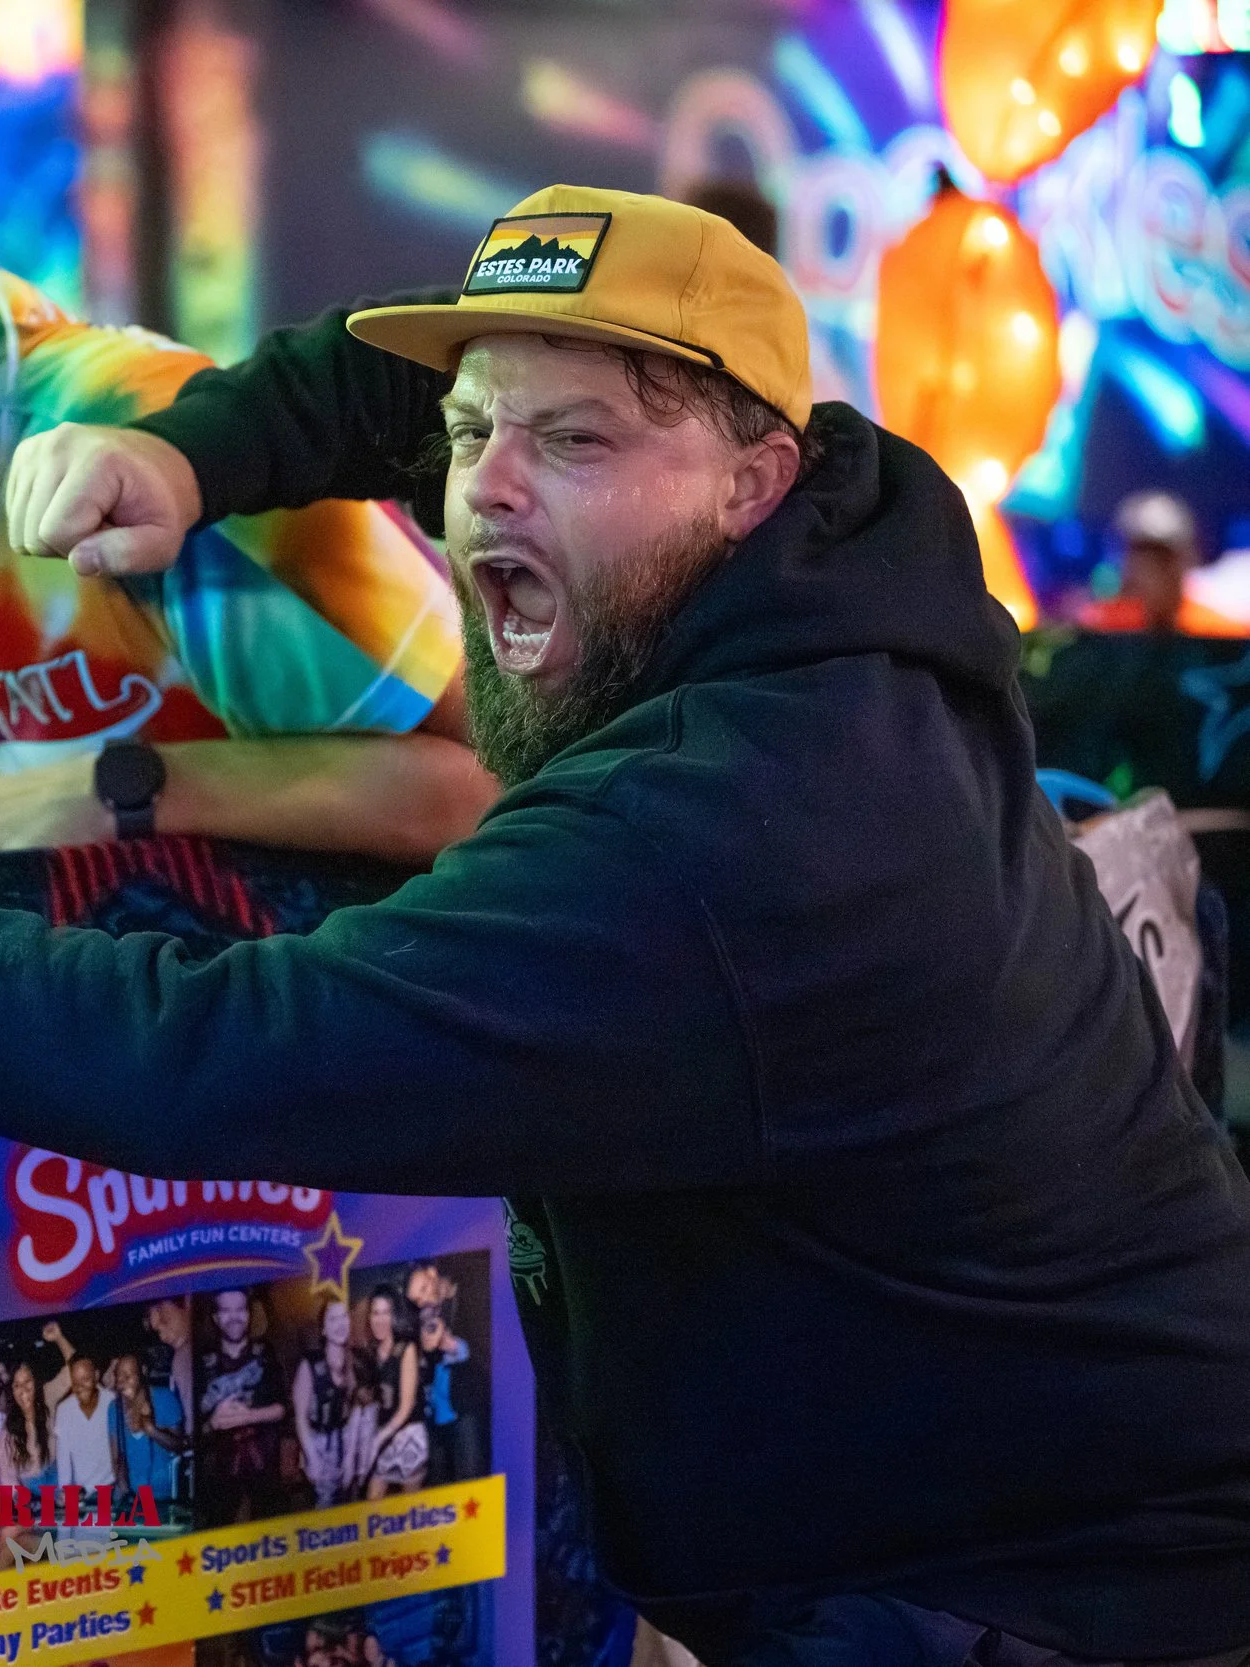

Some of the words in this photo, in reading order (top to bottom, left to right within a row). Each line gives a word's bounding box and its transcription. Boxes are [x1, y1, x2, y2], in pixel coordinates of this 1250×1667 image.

[477, 260, 525, 277] ESTES
[529, 258, 582, 274] PARK
[497, 275, 551, 283] COLORADO
[128, 1234, 187, 1266] FAMILY
[190, 1225, 226, 1247] FUN
[228, 1225, 302, 1248] CENTERS
[201, 1533, 288, 1573] Sports
[297, 1522, 358, 1552] Team
[367, 1503, 456, 1538] Parties
[26, 1567, 122, 1606] Events
[231, 1574, 295, 1608] STEM
[304, 1561, 362, 1593] Field
[369, 1552, 430, 1579] Trips
[31, 1610, 132, 1650] Parties
